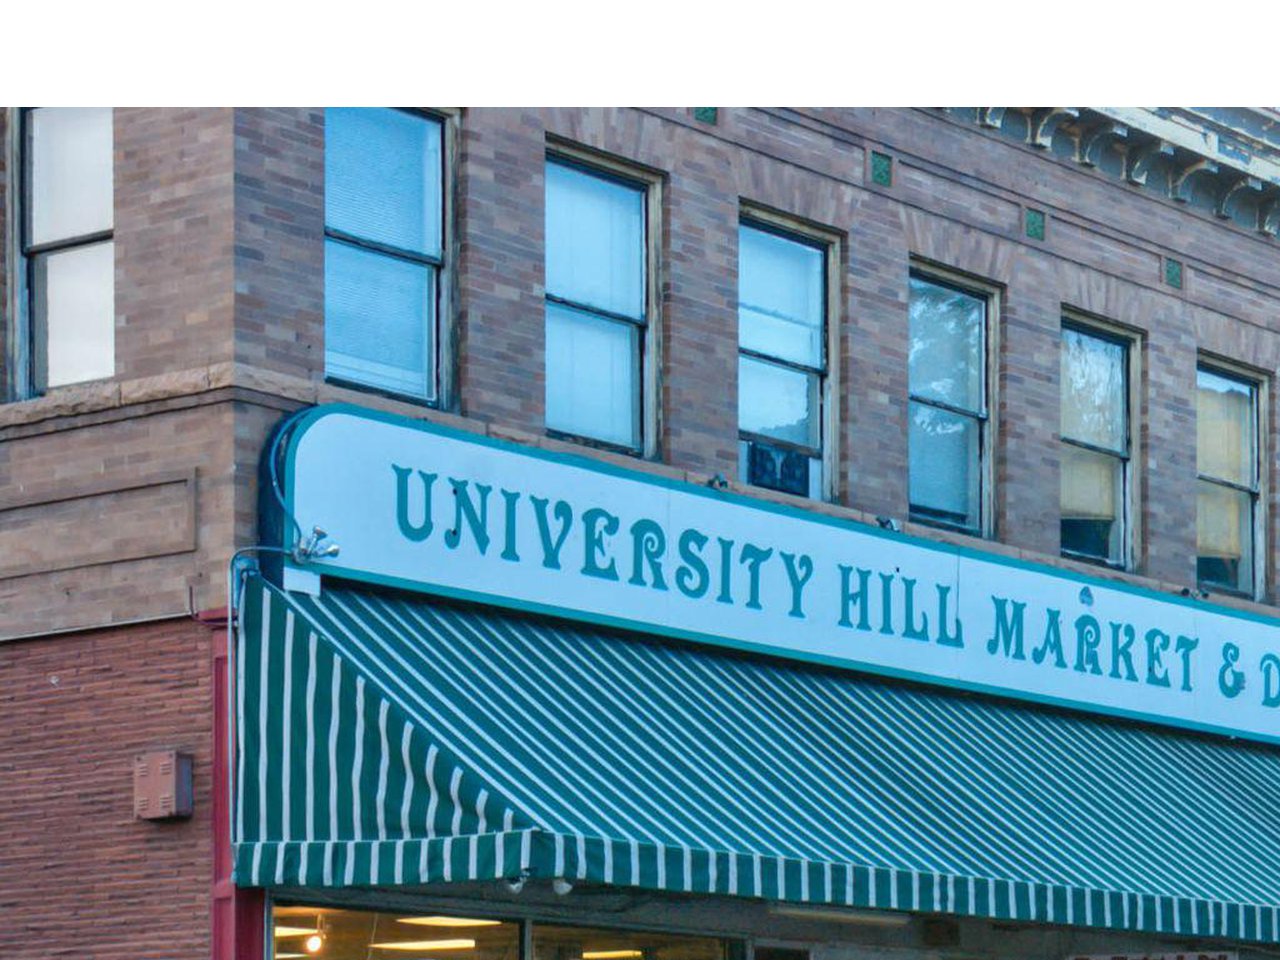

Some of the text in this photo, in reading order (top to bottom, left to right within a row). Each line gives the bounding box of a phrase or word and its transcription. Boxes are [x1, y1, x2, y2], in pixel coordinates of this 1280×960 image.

[391, 463, 814, 619] UNIVERSITY
[837, 564, 965, 649] HILL
[987, 595, 1200, 692] MARKET
[1218, 642, 1246, 699] &
